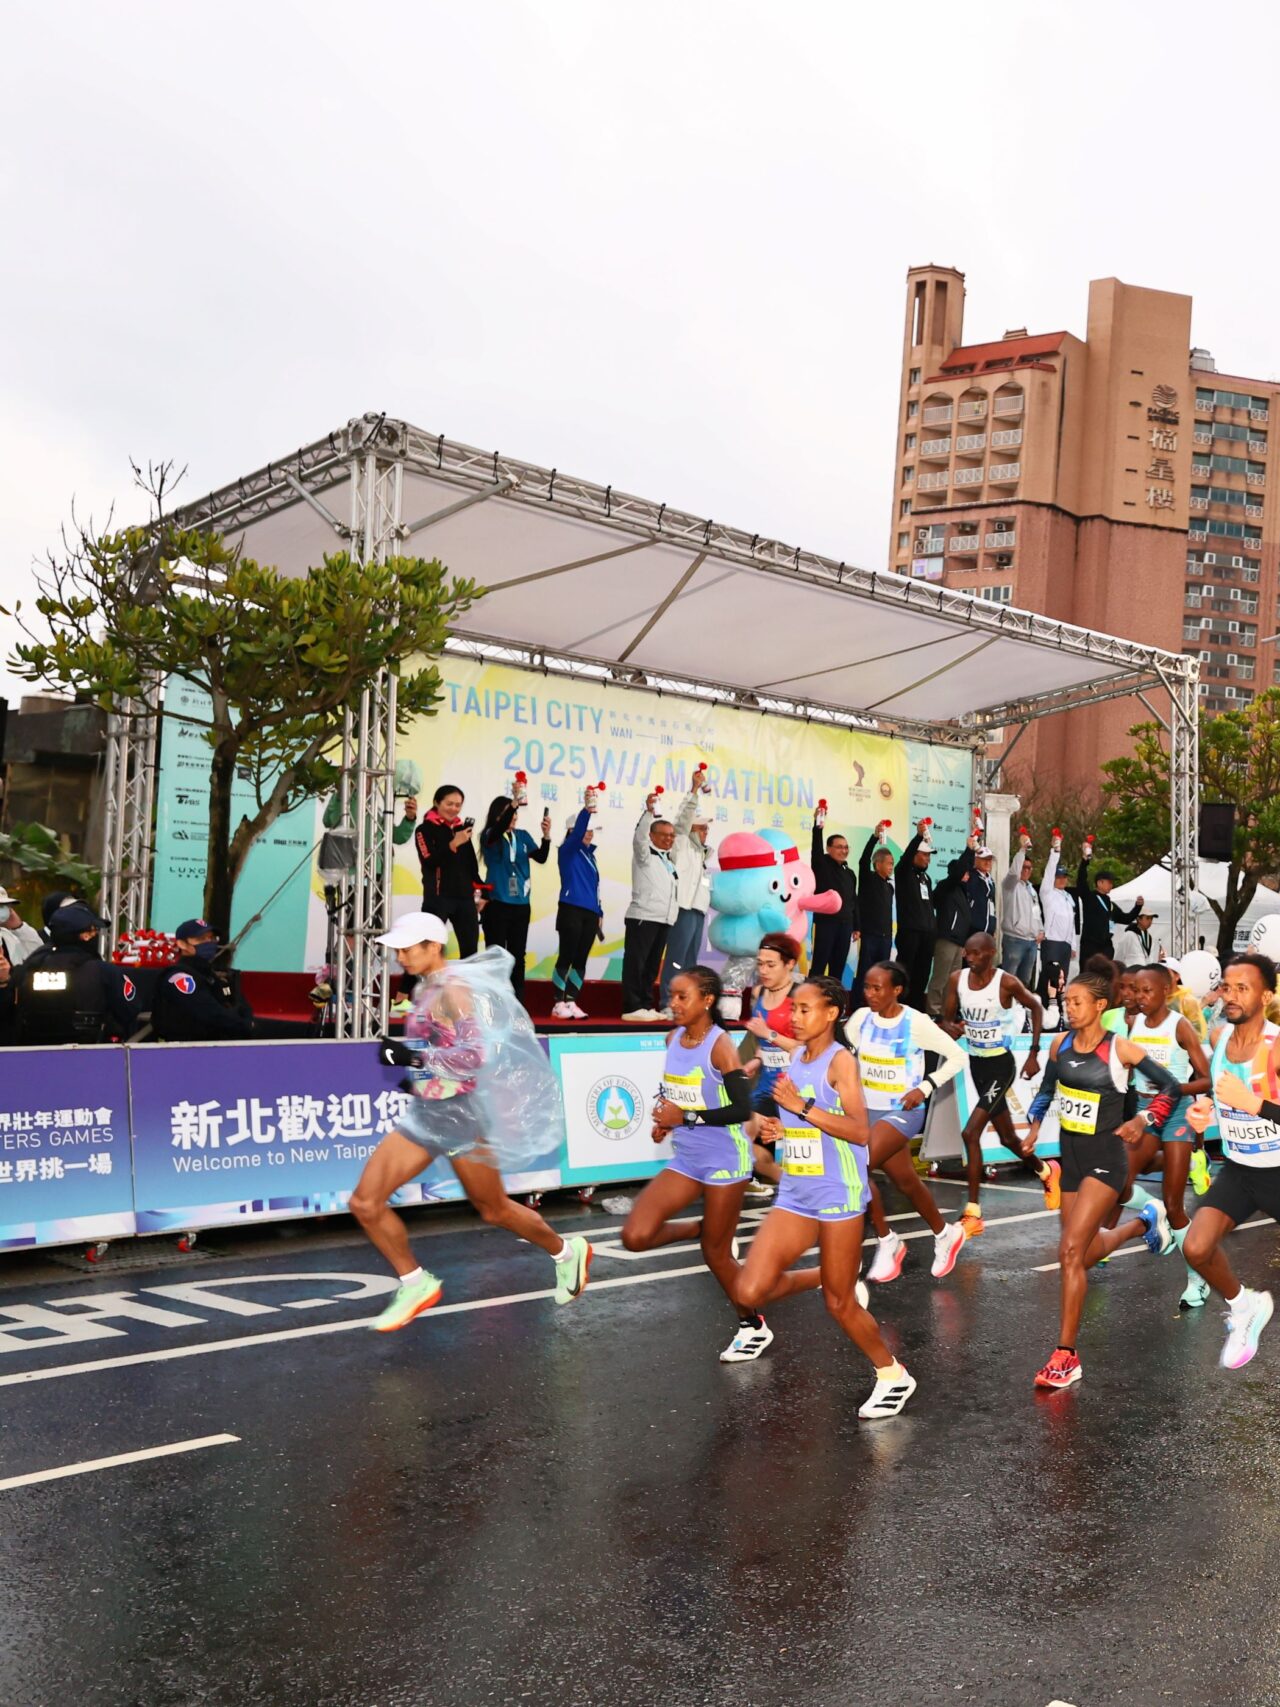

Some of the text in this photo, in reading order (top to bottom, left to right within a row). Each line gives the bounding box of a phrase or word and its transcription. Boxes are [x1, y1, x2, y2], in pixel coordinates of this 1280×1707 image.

[445, 682, 604, 734] TAIPEI CITY
[610, 725, 633, 739] WAN
[503, 736, 586, 779] 2025
[664, 758, 815, 809] MRATHON
[967, 1028, 997, 1039] 10127
[767, 1055, 785, 1064] YEH
[866, 1067, 897, 1080] AMID
[170, 1091, 411, 1150] 新北歡迎您
[1227, 1120, 1278, 1139] HUSEN
[49, 1127, 114, 1146] GAMES
[172, 1141, 382, 1173] Welcome to New Taipe
